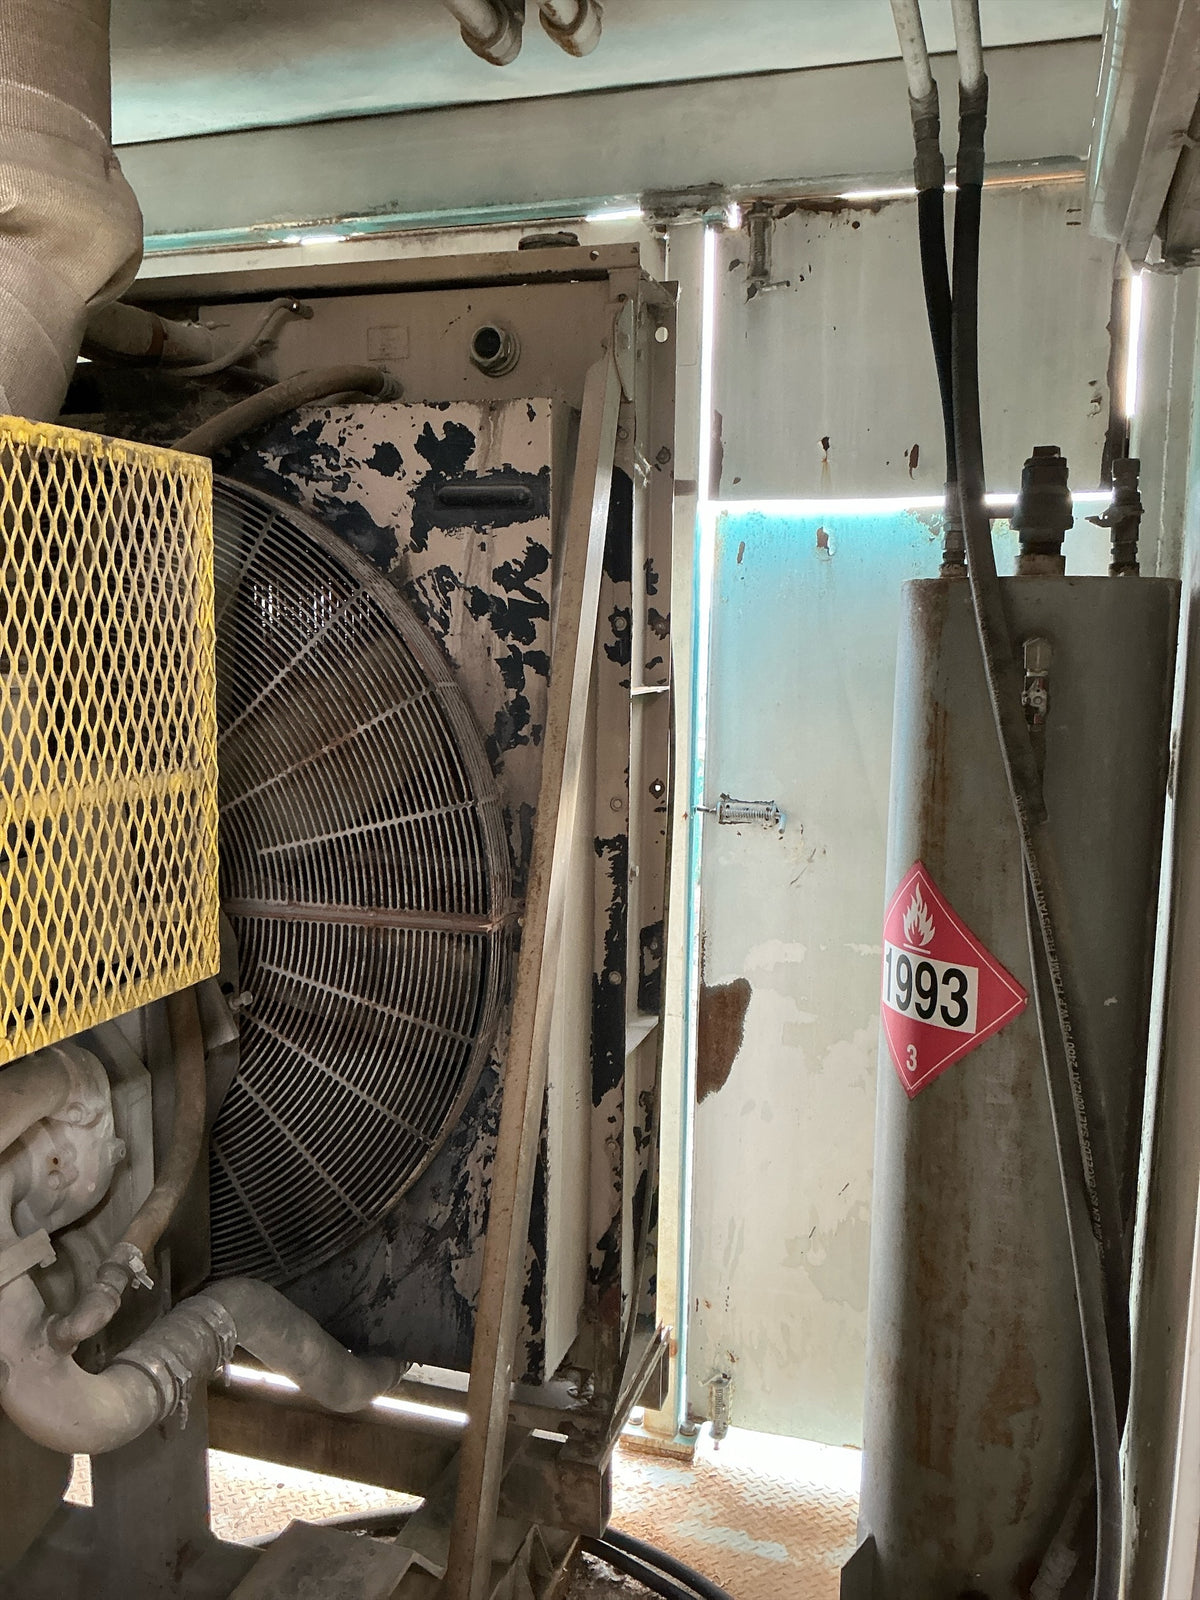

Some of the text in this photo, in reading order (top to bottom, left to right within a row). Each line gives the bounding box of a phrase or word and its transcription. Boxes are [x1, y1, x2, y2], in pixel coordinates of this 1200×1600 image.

[1036, 888, 1055, 952] RESISTANT
[885, 947, 969, 1027] 1993
[1051, 952, 1064, 995] FLAME
[906, 1044, 918, 1072] 3
[1066, 1040, 1078, 1068] 2400
[1079, 1115, 1089, 1138] SAE
[1082, 1139, 1096, 1188] EXCEEDS
